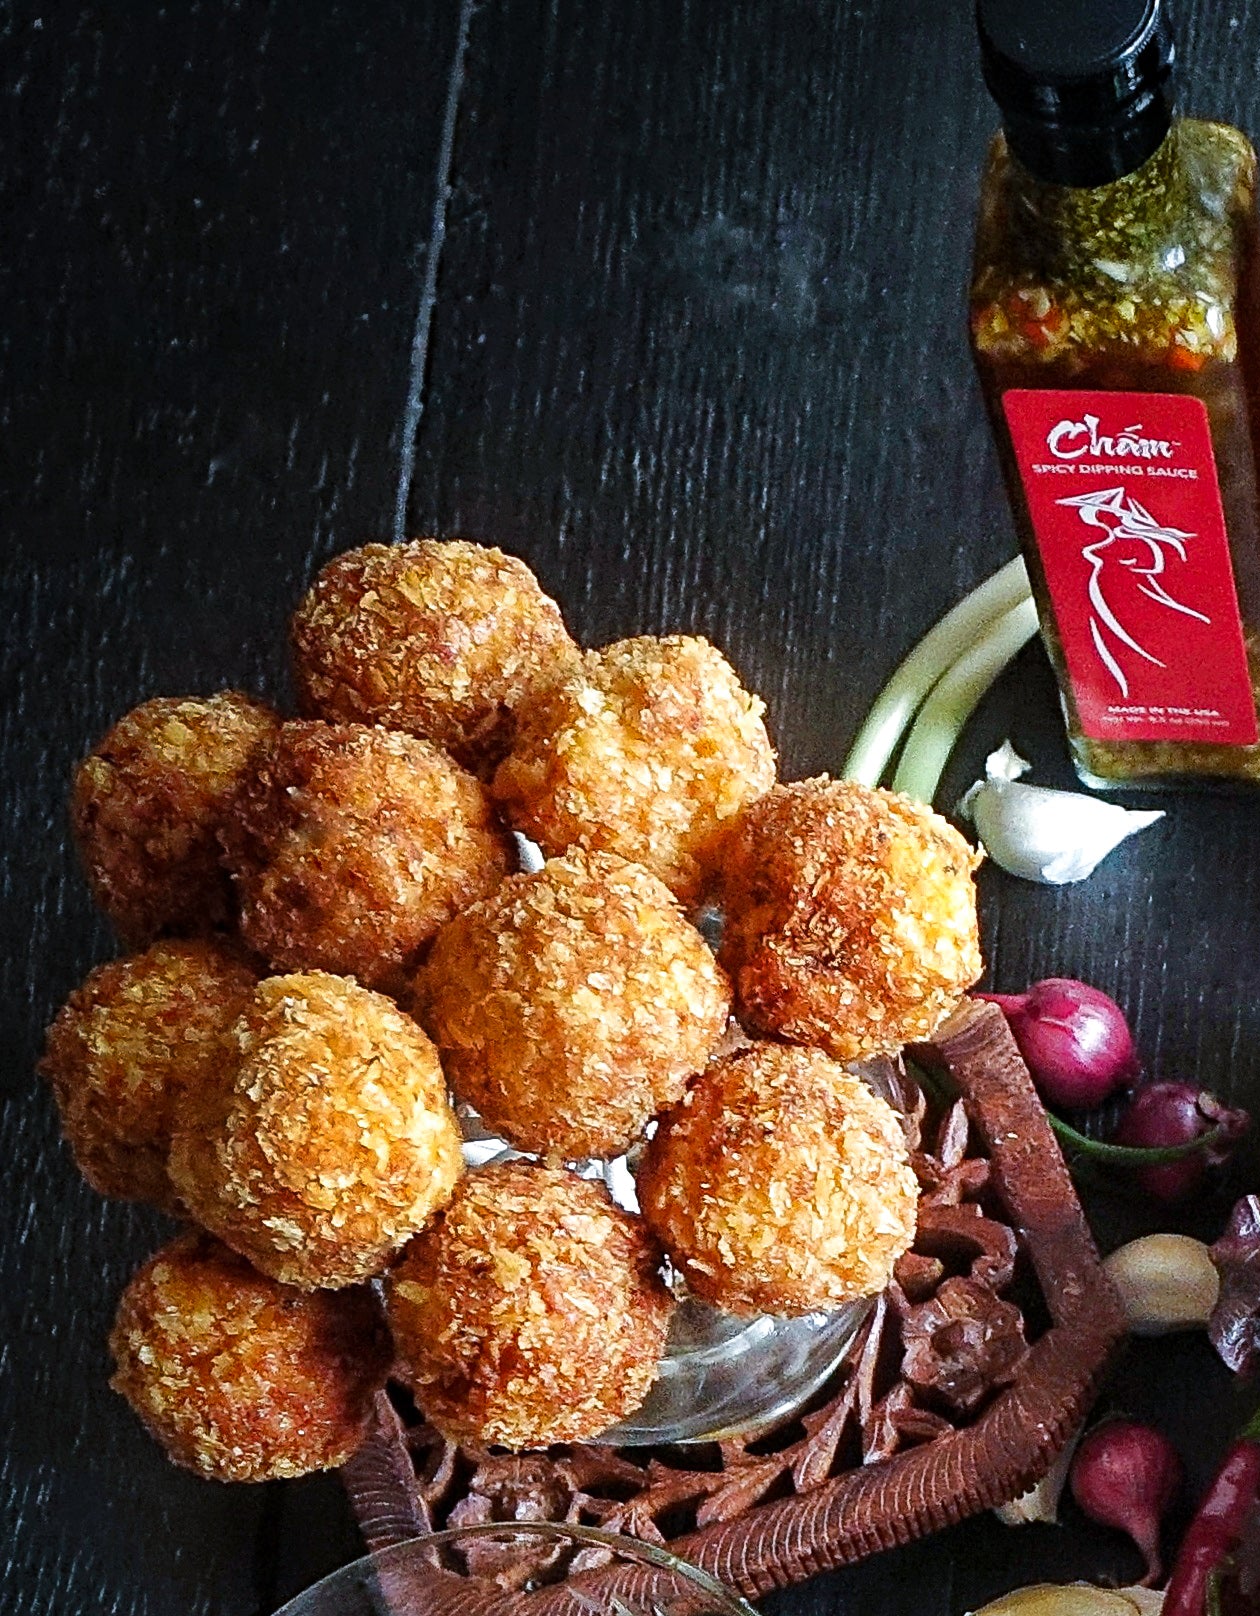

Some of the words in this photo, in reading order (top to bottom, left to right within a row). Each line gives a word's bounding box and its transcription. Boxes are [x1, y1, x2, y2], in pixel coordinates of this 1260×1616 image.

[1031, 463, 1076, 474] SPICY
[1079, 464, 1144, 475] DIPPING
[1147, 467, 1199, 480] SAUCE
[1107, 704, 1146, 714] MADE
[1148, 706, 1164, 715] IN
[1166, 706, 1192, 716] THE
[1194, 708, 1220, 717] USA
